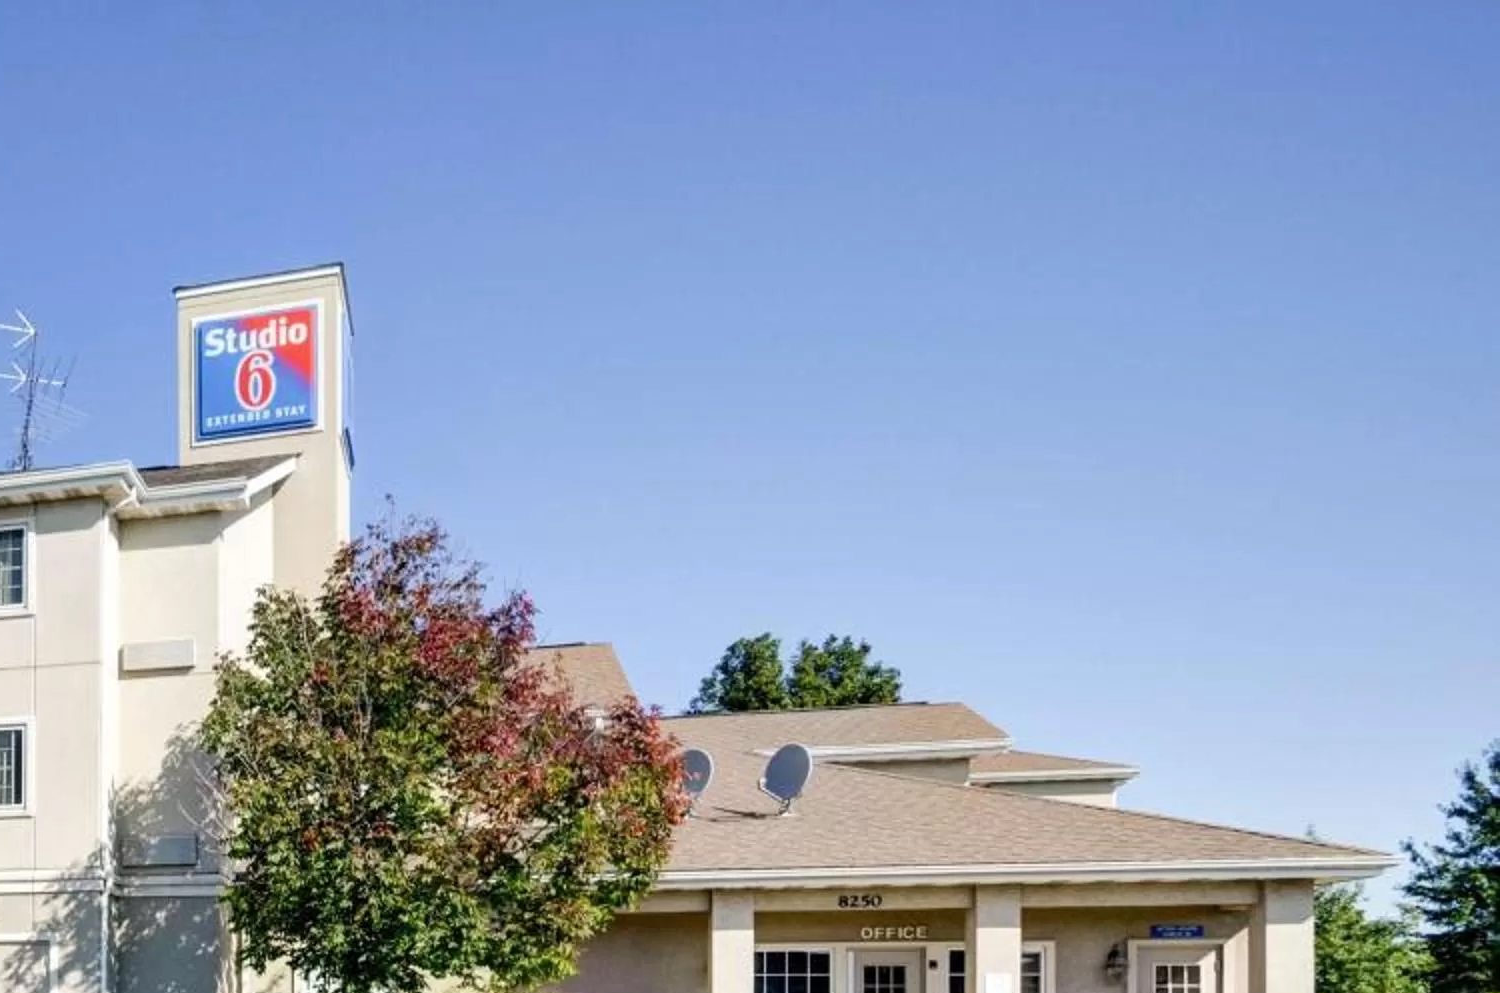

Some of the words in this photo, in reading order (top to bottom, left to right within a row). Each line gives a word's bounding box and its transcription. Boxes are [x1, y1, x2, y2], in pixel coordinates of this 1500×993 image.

[204, 317, 308, 357] Studio
[234, 350, 276, 411] 6
[206, 409, 271, 427] EXTENDED
[276, 403, 306, 418] STAY
[838, 895, 883, 908] 8250
[860, 926, 928, 939] OFFICE
